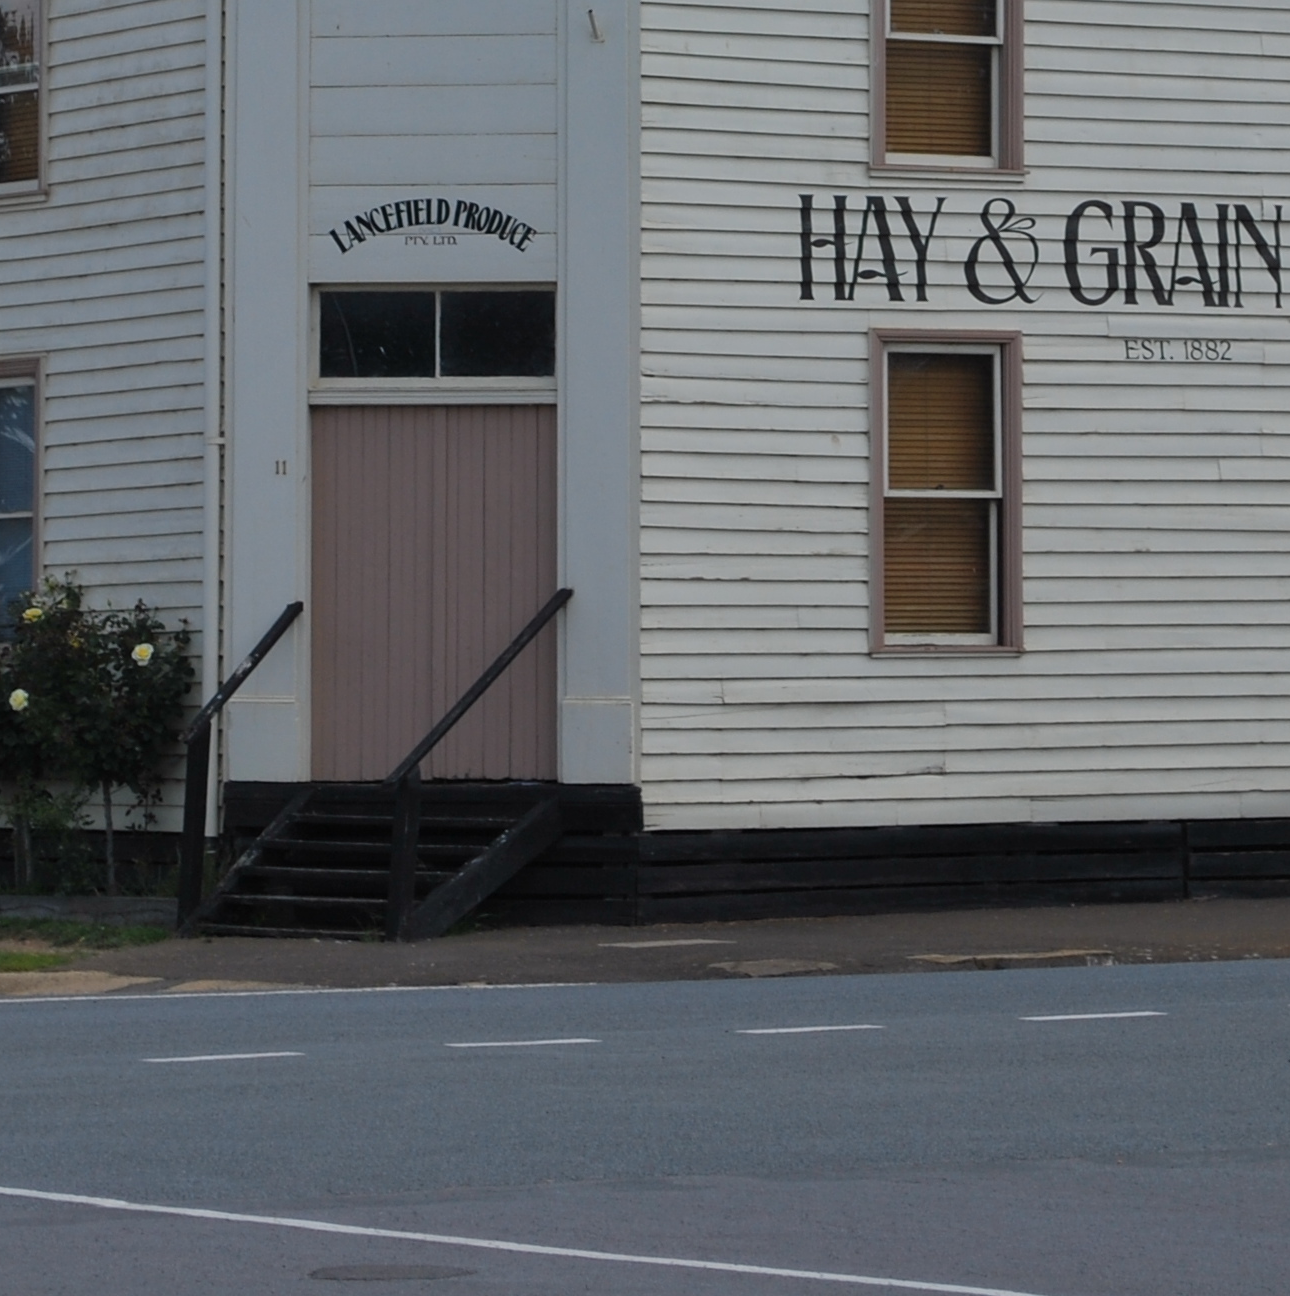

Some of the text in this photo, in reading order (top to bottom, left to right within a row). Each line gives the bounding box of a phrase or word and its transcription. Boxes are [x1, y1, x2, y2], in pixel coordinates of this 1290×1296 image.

[328, 197, 538, 255] LANCEFIELD PRODUCE
[798, 192, 949, 303] HAY
[963, 197, 1045, 307] &
[1062, 199, 1284, 310] GRAIN
[1123, 338, 1233, 362] EST. 1882
